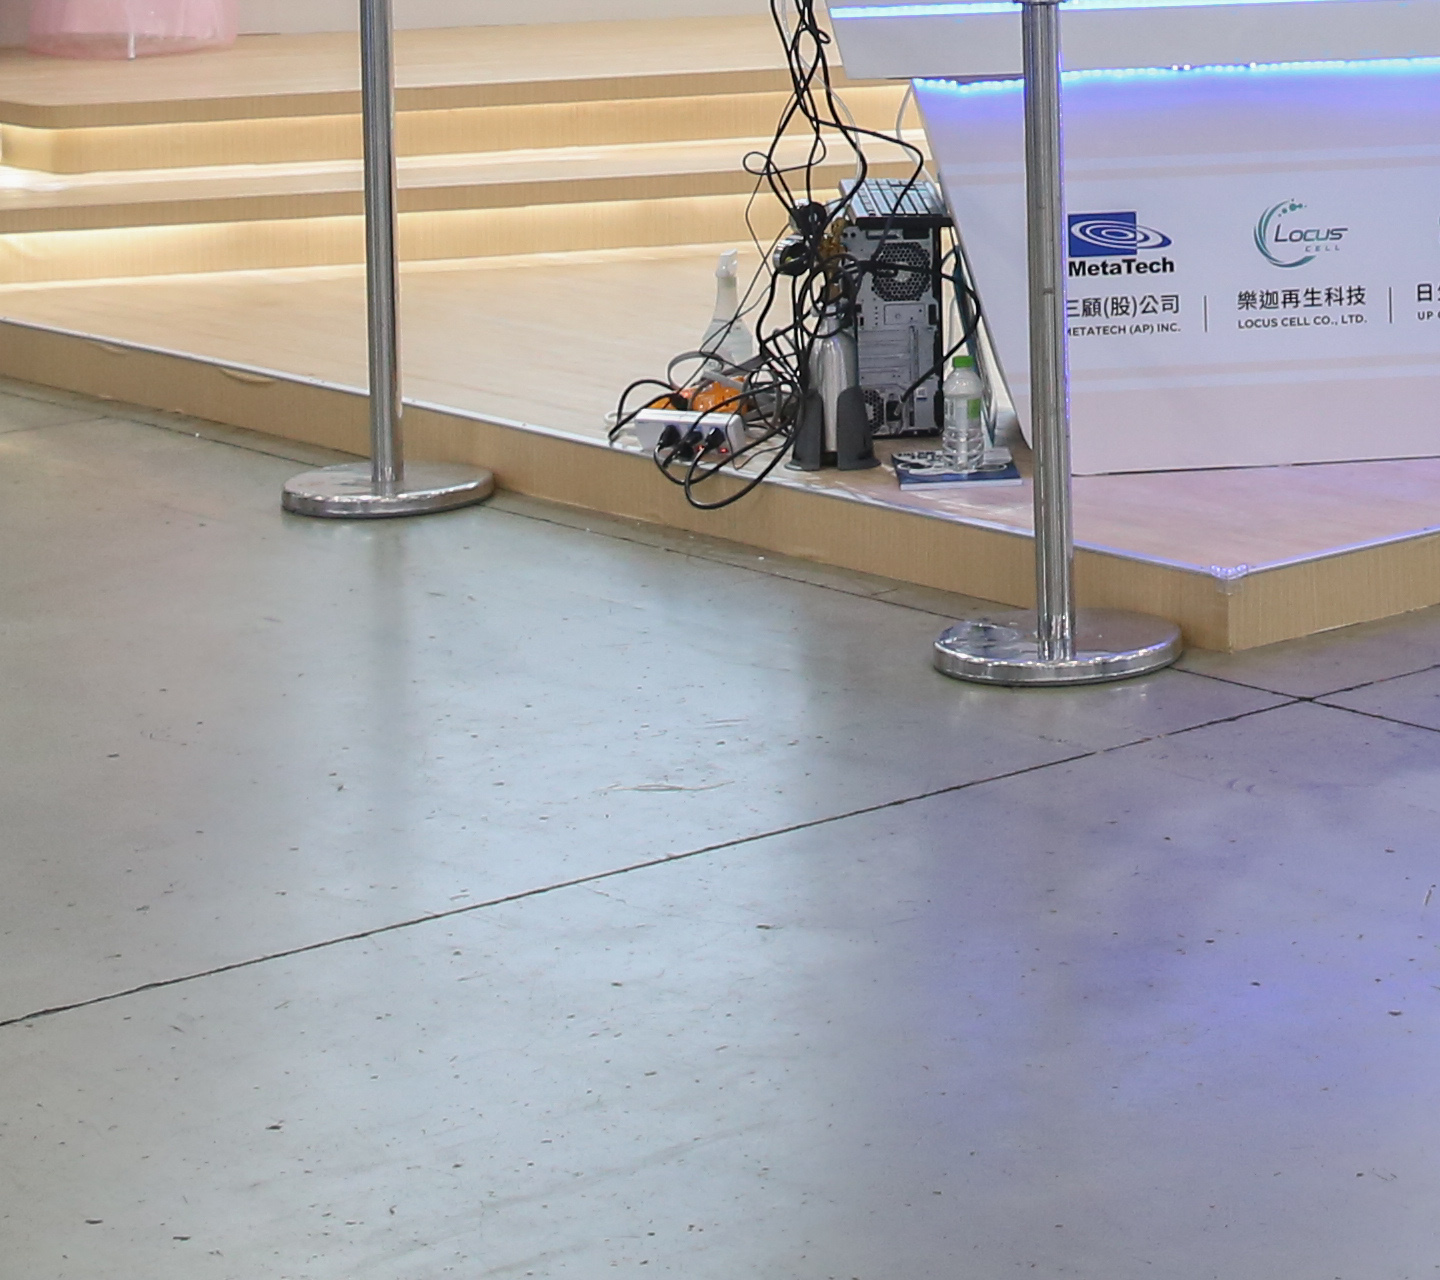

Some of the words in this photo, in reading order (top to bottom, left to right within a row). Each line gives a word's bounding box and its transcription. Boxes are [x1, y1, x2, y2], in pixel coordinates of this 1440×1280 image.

[1068, 257, 1175, 277] MetaTech
[1238, 285, 1366, 310] 樂迦再生科技
[1238, 318, 1278, 329] LOCUS
[1281, 316, 1310, 327] CELL
[1341, 314, 1367, 324] LTD.
[1418, 311, 1434, 320] UP
[1129, 324, 1154, 335] (AP)
[1157, 322, 1181, 332] INC.
